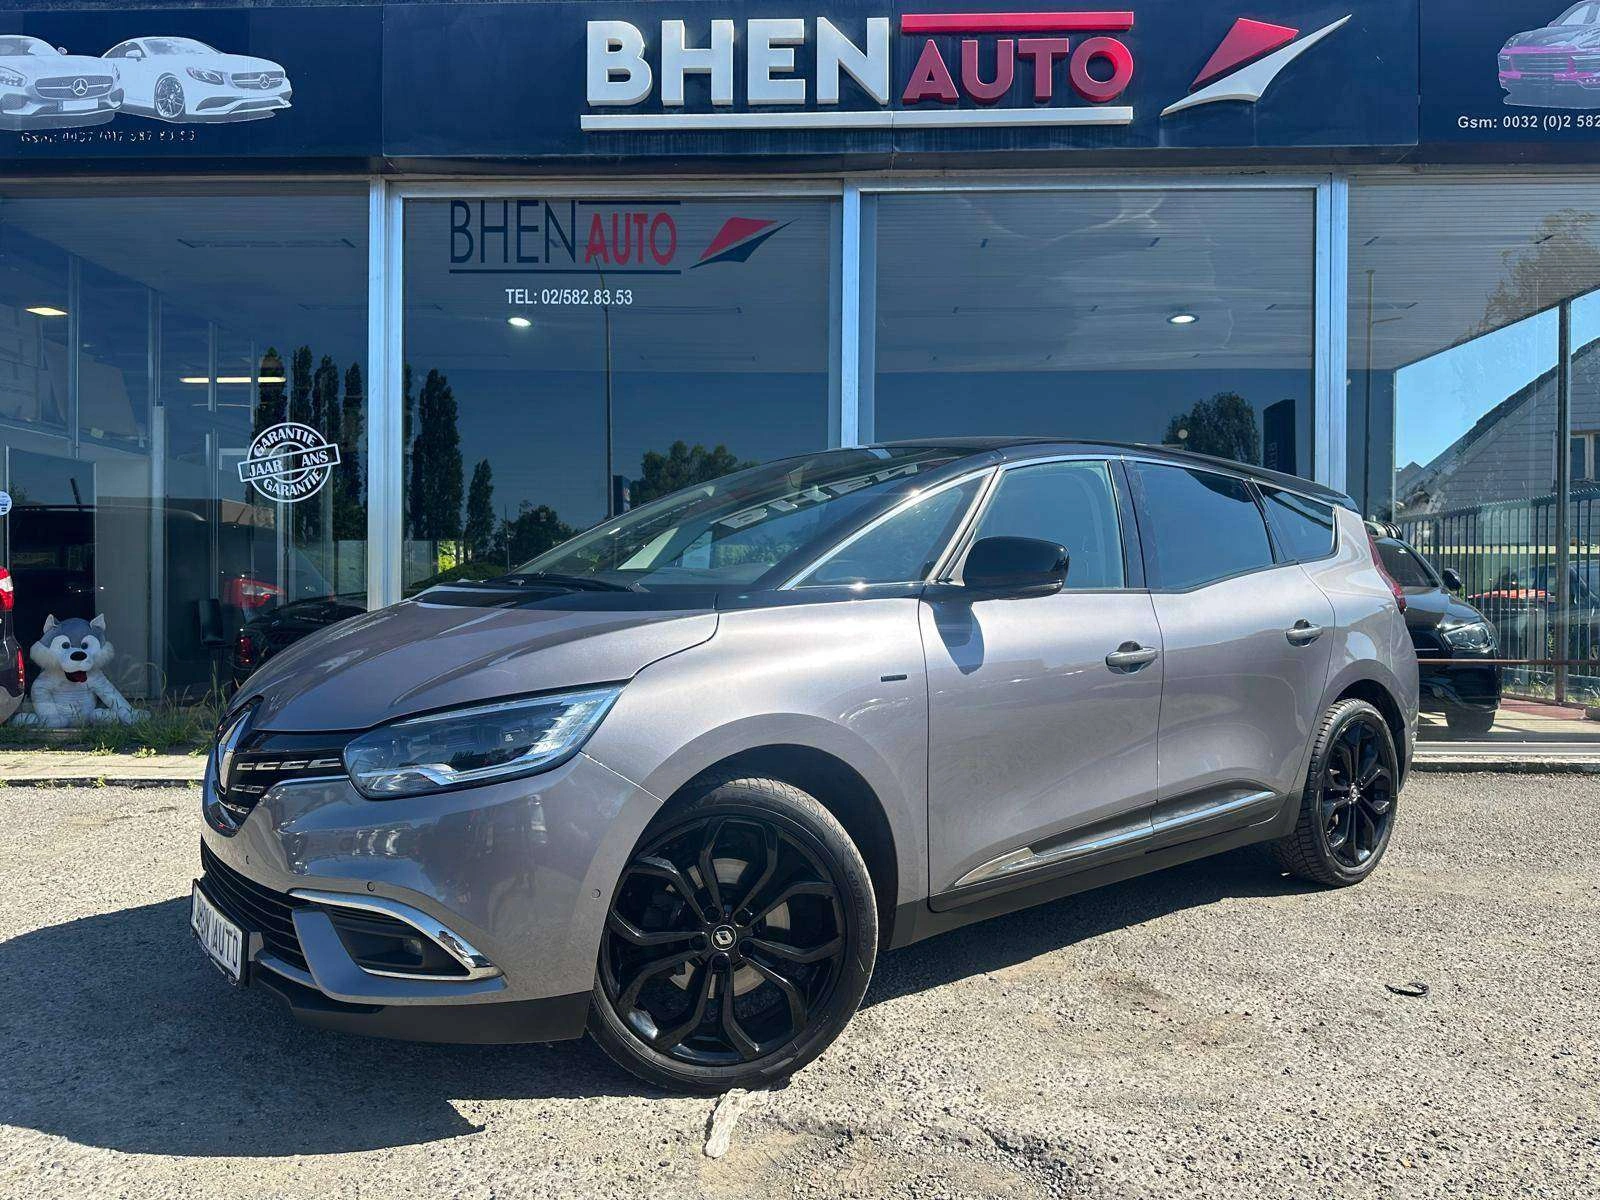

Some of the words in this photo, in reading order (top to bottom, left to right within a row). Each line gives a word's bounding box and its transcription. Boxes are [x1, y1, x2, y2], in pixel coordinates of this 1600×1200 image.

[587, 17, 889, 106] BHEN
[902, 37, 1134, 102] AUTO
[1457, 115, 1498, 129] Gsm:
[1503, 115, 1538, 128] 0032
[1543, 115, 1571, 131] (0)2
[450, 198, 577, 264] BHEN
[585, 212, 677, 266] AUTO
[505, 288, 538, 305] TEL:
[541, 288, 633, 306] 02/582.83.53
[253, 427, 318, 458] GARANTIE
[249, 460, 284, 477] JAAR
[301, 450, 329, 468] ANS
[263, 467, 324, 497] GARANTIE
